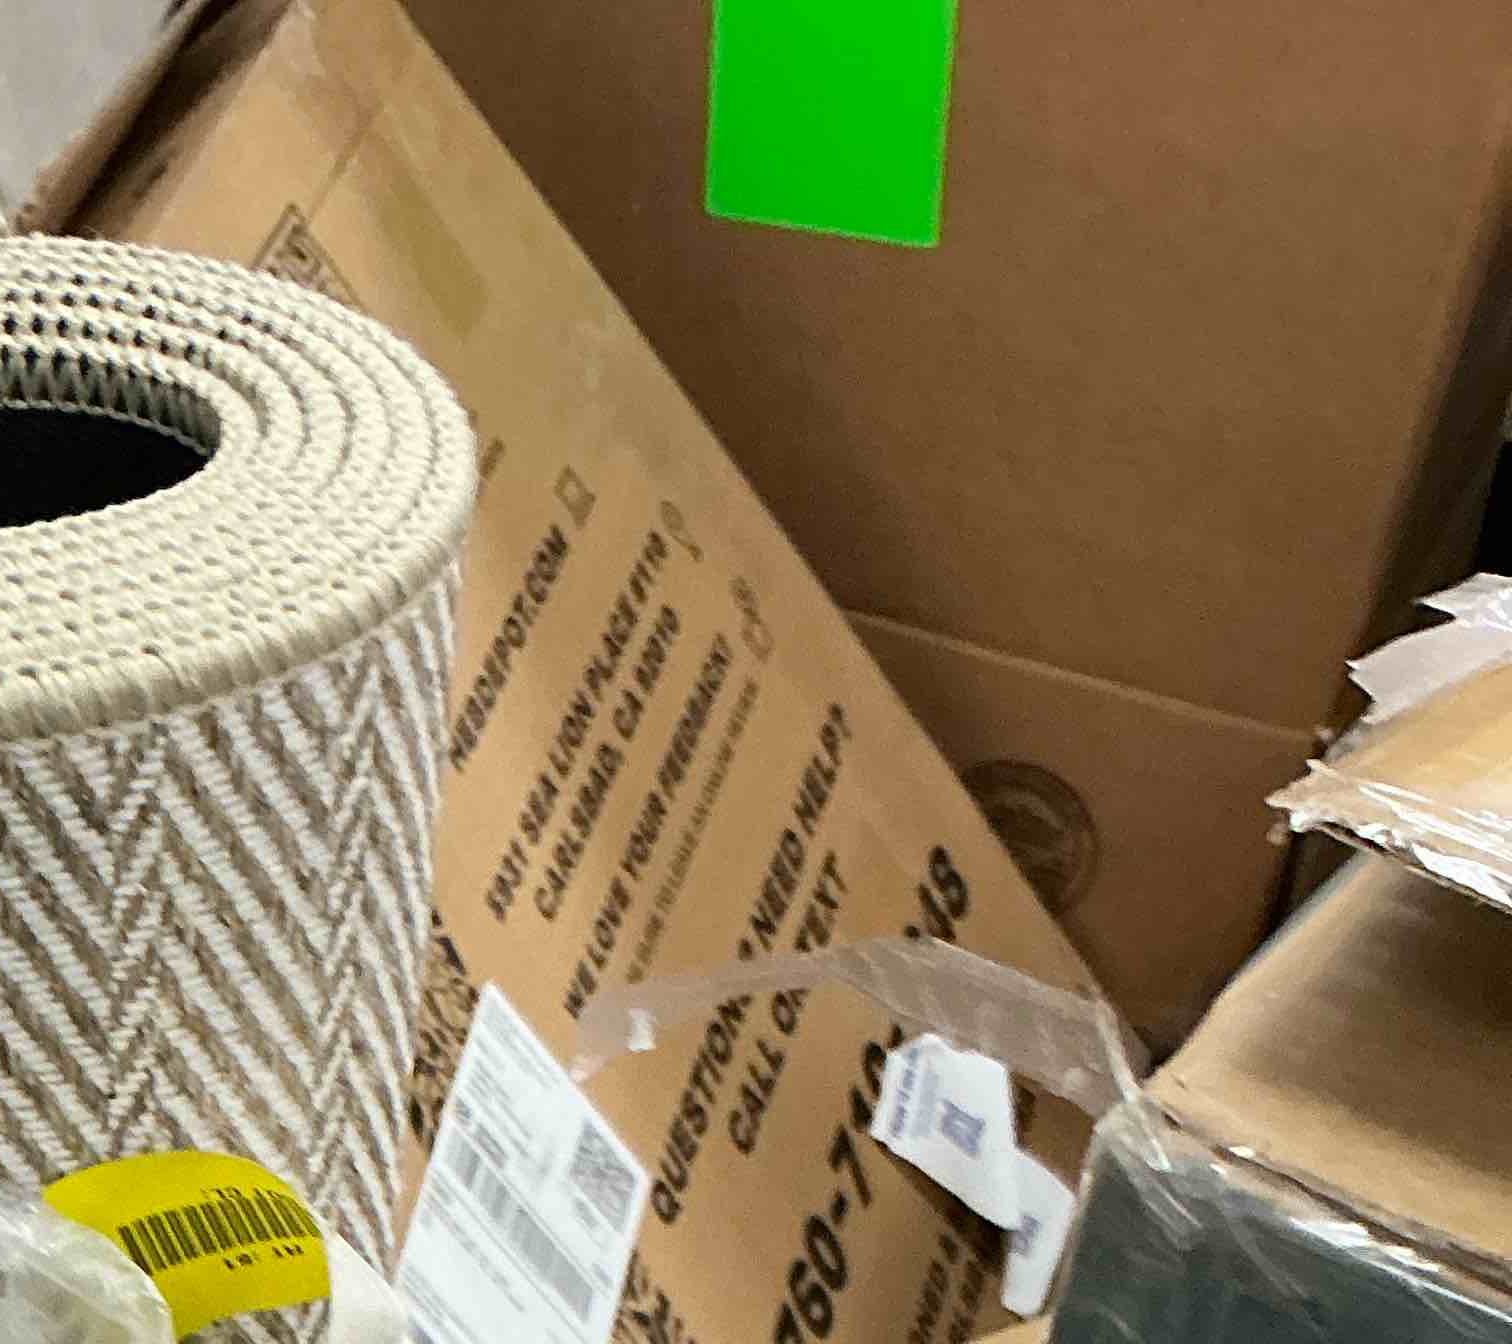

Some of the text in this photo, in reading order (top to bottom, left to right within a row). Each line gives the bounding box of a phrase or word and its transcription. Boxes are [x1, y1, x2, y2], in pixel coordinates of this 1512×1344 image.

[521, 773, 560, 843] SEA
[549, 691, 595, 777] LION
[585, 595, 639, 698] PLACE
[613, 690, 644, 740] CA
[588, 877, 632, 969] LOVE
[621, 792, 668, 880] YOUR
[751, 829, 803, 944] NEED
[793, 703, 851, 836] HELP?
[729, 1040, 785, 1155] CALL
